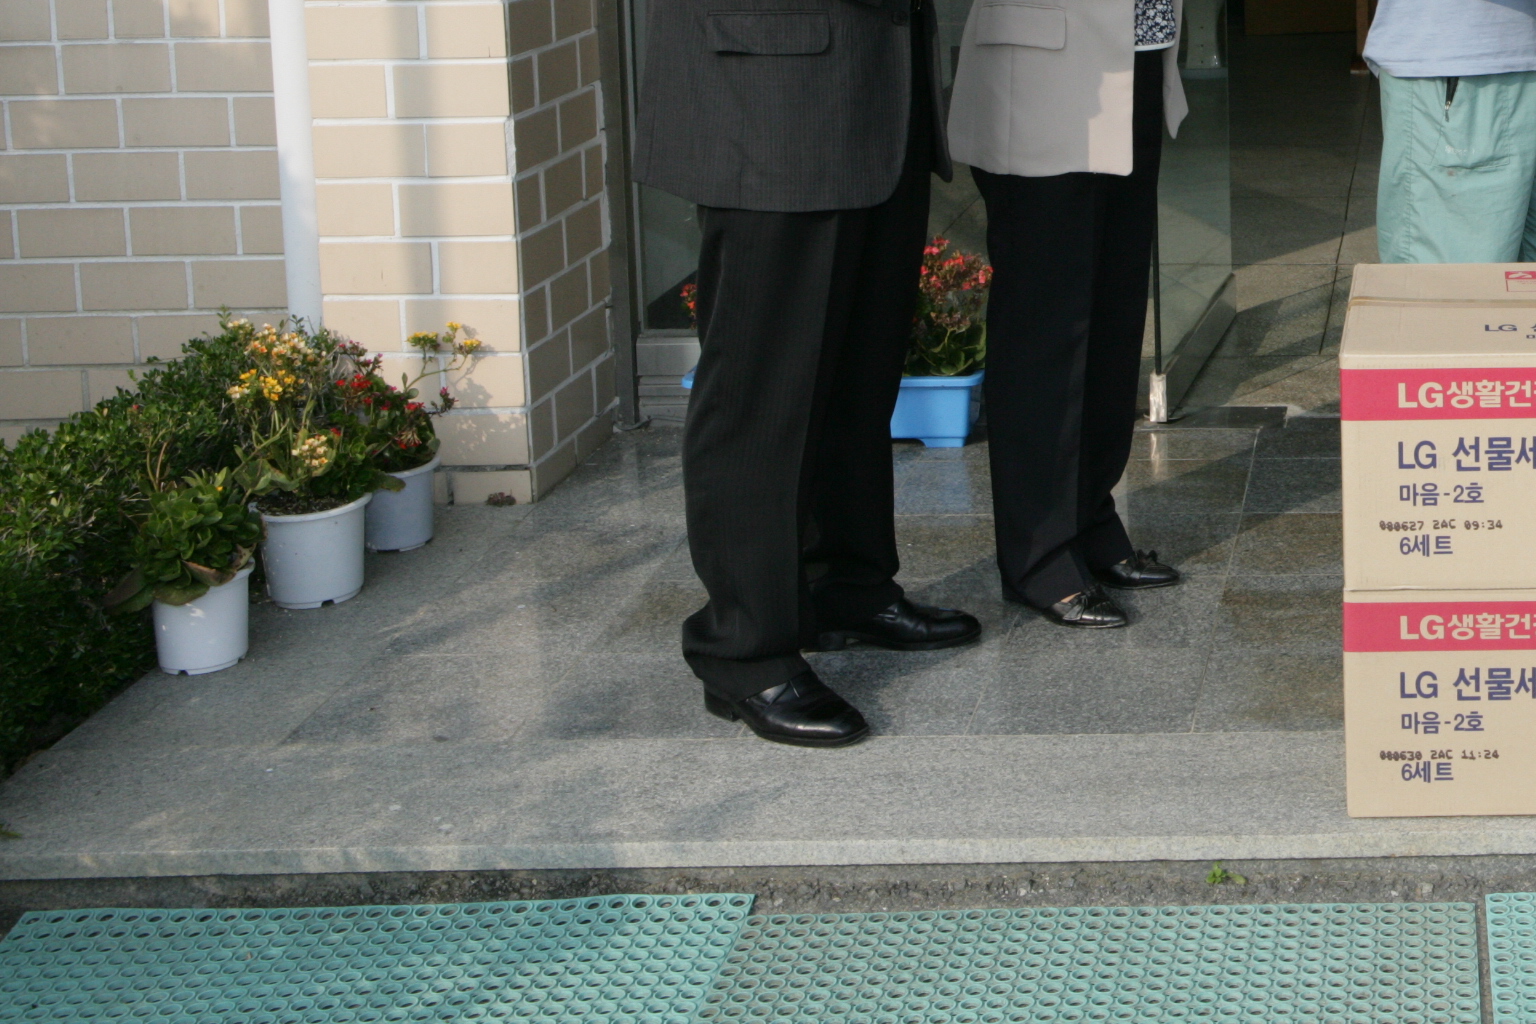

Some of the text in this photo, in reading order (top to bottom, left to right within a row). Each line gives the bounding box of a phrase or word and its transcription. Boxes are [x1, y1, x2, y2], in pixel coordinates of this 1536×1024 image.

[1484, 324, 1517, 332] LG
[1398, 440, 1437, 469] LG
[1400, 482, 1484, 506] 마음-2호
[1464, 519, 1503, 530] 09:34
[1400, 534, 1453, 557] 6세트
[1400, 671, 1438, 698] LG
[1401, 711, 1484, 734] 마음-2호
[1401, 761, 1454, 783] 6세트
